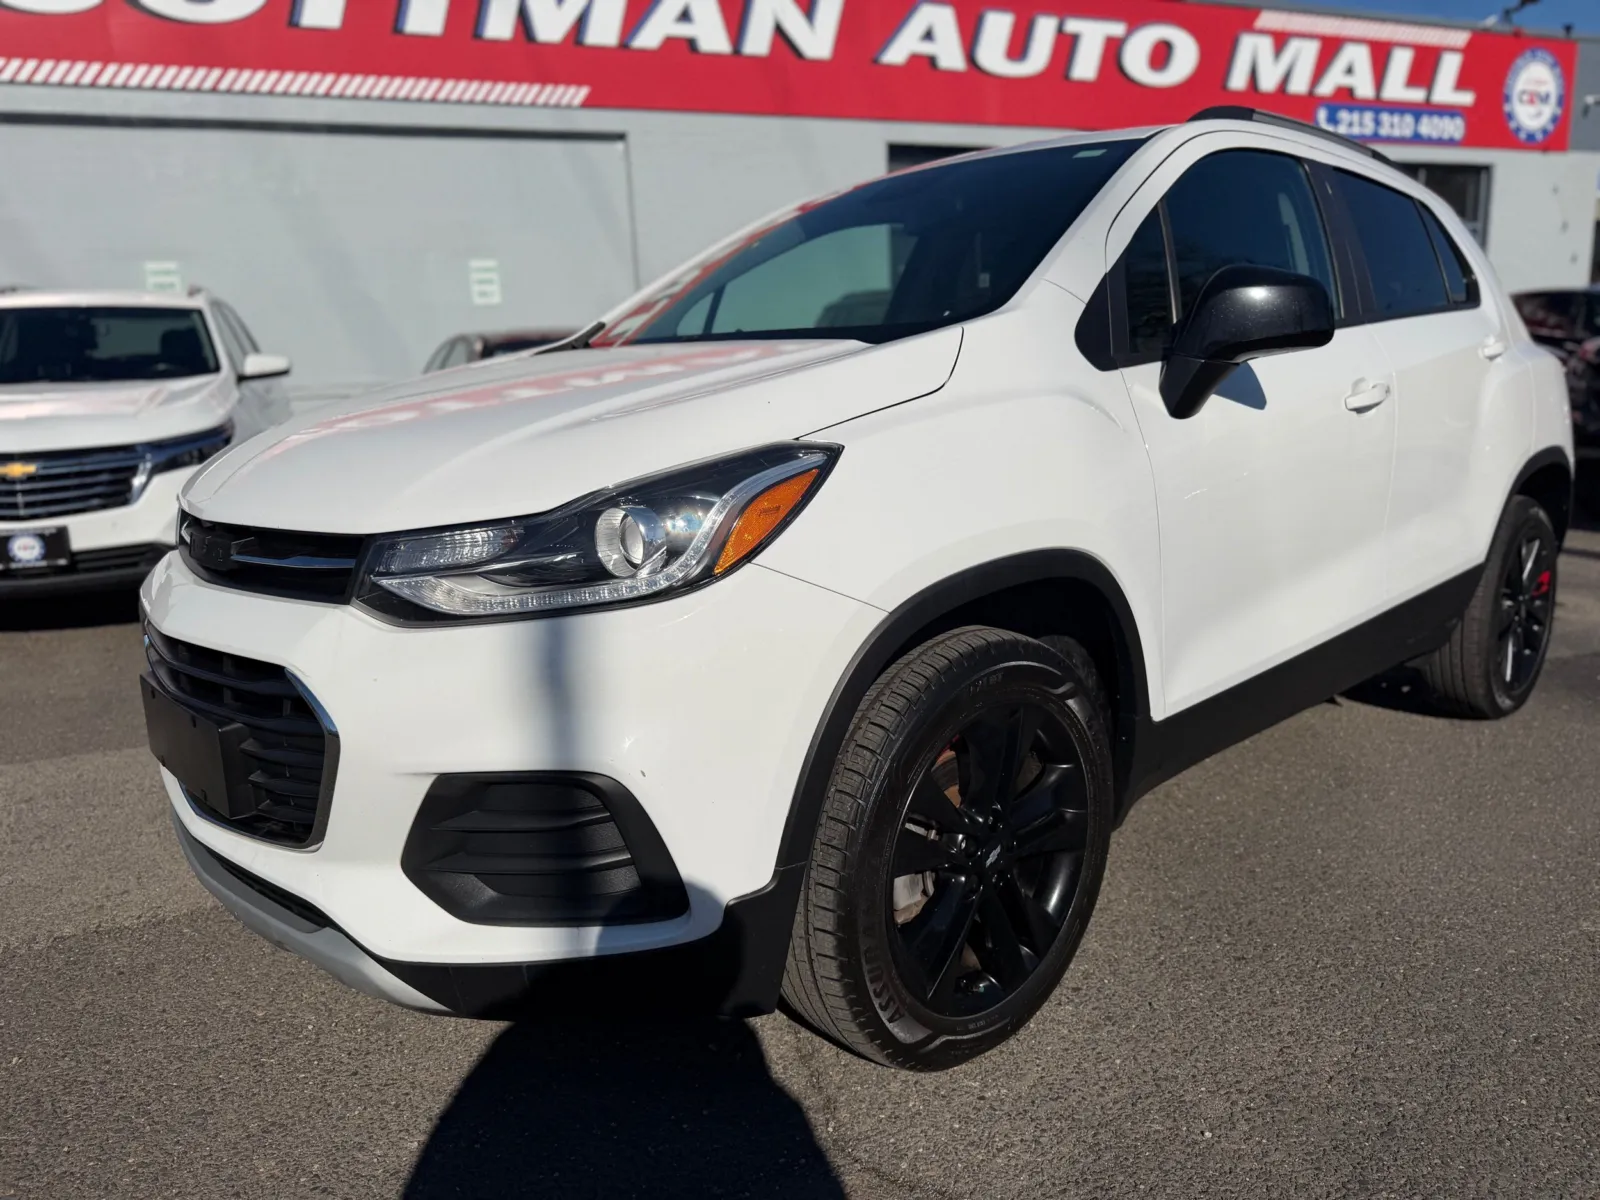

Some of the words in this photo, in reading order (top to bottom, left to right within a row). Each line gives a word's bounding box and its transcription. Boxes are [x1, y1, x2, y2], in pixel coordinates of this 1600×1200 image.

[878, 2, 1200, 88] AUTO
[1226, 32, 1476, 106] MALL
[1336, 108, 1375, 136] 215
[1377, 111, 1415, 139] 310
